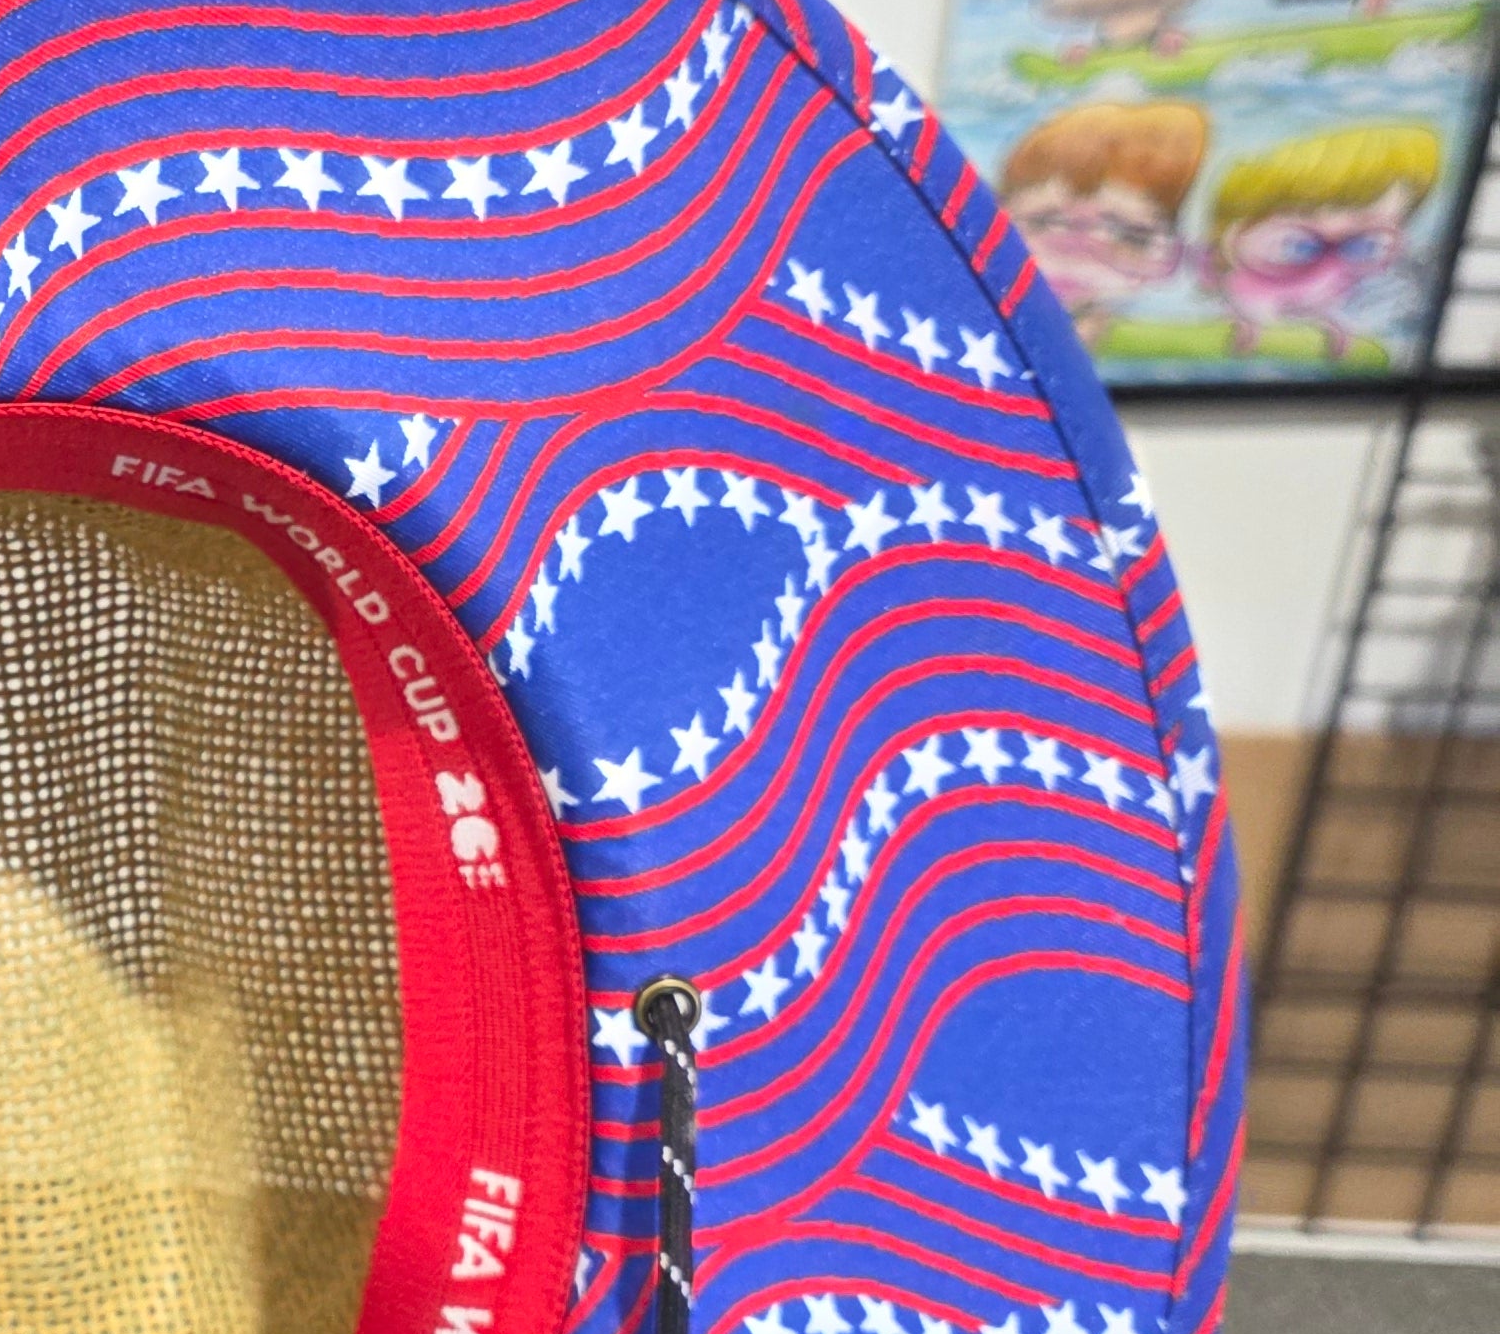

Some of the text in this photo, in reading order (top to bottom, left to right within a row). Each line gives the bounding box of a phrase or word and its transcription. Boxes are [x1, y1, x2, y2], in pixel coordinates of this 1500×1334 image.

[111, 453, 217, 500] FIFA
[242, 493, 390, 626] WORLD
[388, 644, 461, 744] CUP
[451, 1167, 522, 1279] FIFA
